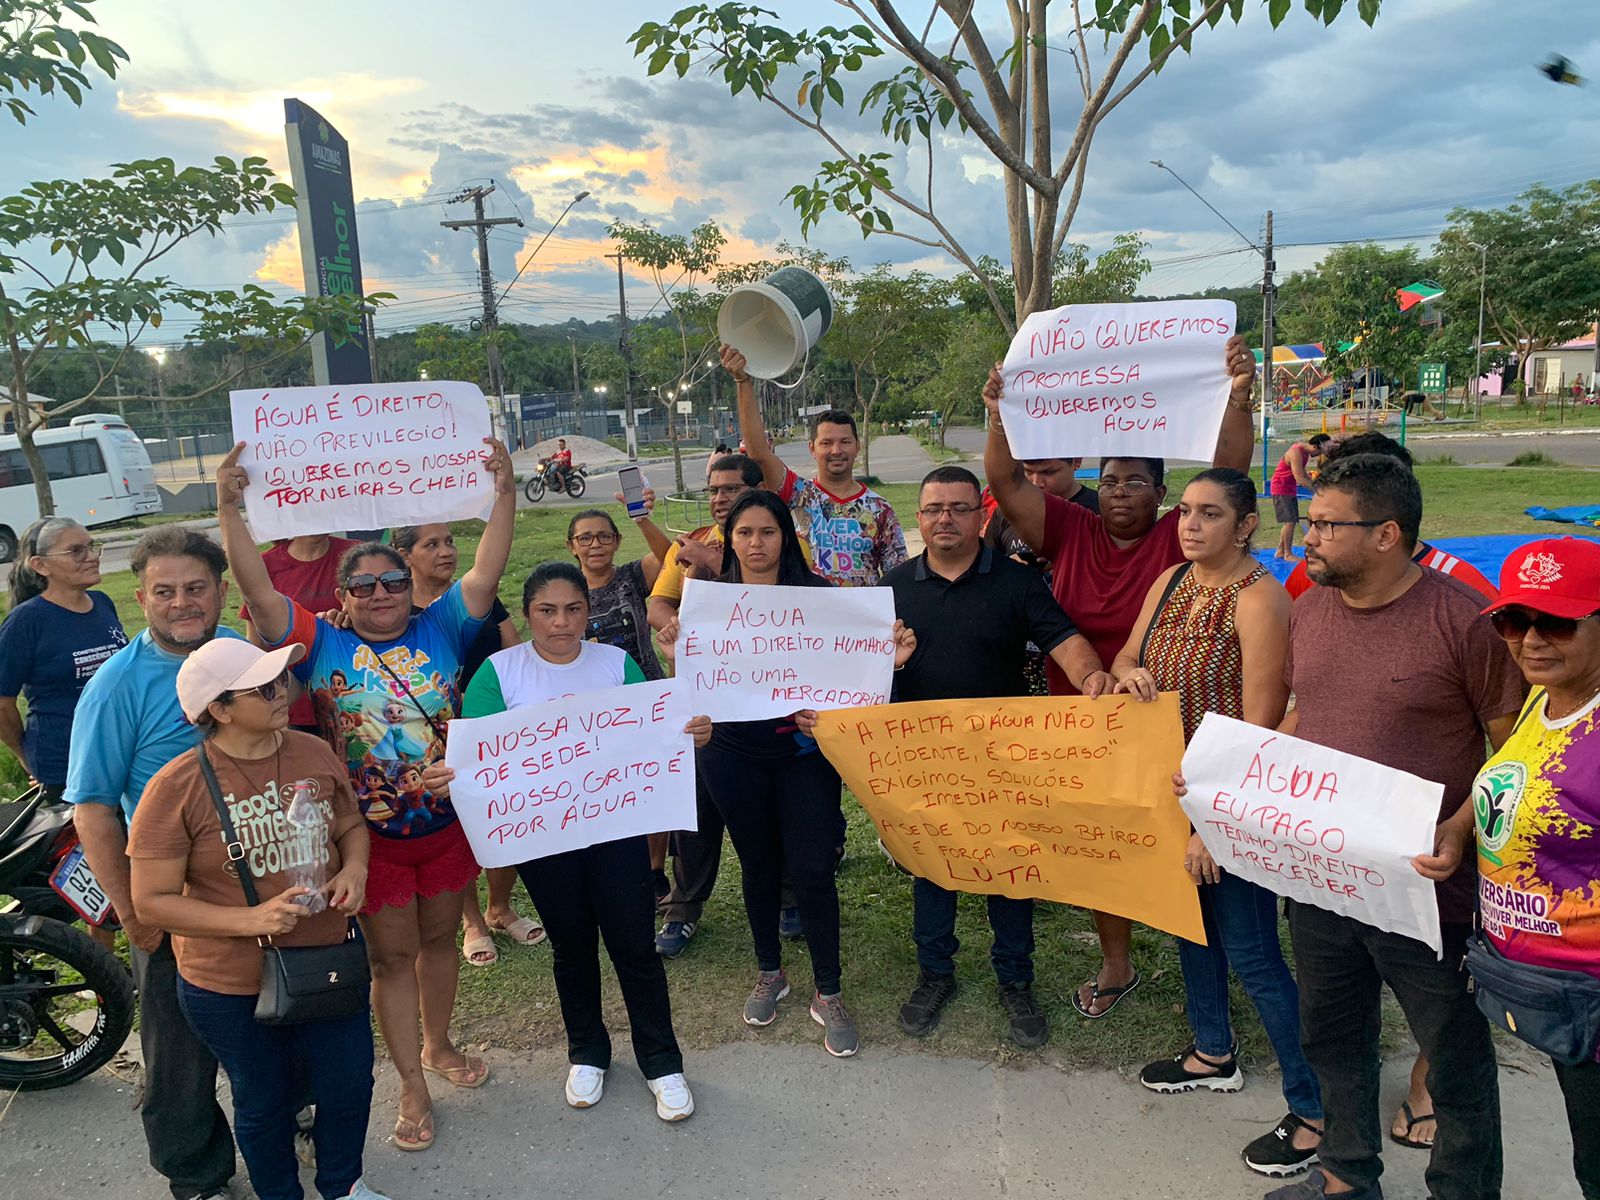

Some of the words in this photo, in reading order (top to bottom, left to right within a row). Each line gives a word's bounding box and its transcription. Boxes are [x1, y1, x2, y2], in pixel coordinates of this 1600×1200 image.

[1030, 317, 1085, 358] NÃO
[1096, 317, 1230, 349] QUEREMOS
[1012, 363, 1140, 392] PROMESSA
[255, 393, 318, 433] ÁGUA
[327, 392, 343, 420] É
[1026, 392, 1157, 418] QUEREMOS
[255, 433, 307, 461] NÃO
[265, 459, 410, 486] QUEREMOS
[422, 449, 489, 471] NOSSAS
[409, 469, 477, 494] CHEIA
[818, 549, 864, 571] KIDS
[726, 591, 805, 631] ÁGUA
[685, 631, 702, 656] É
[712, 639, 741, 656] UM
[752, 632, 824, 655] DIREITO
[696, 661, 741, 691] NÃO
[751, 667, 798, 684] UMA
[772, 685, 885, 706] MERCADORIA
[478, 716, 568, 761] NOSSA
[651, 691, 672, 722] É
[885, 715, 953, 739] FALTA
[1106, 702, 1126, 731] É
[475, 762, 510, 788] DE
[521, 736, 600, 775] SEDE!
[986, 741, 999, 761] É
[583, 761, 660, 793] GRITO
[668, 750, 686, 773] É
[868, 769, 976, 795] EXIGIMOS
[488, 815, 547, 844] POR
[881, 819, 895, 832] A
[899, 823, 952, 836] SEDE
[962, 821, 991, 835] DO
[1002, 819, 1063, 834] NOSSO
[1074, 824, 1157, 848] BAIRRO
[1212, 791, 1248, 821] EU
[1251, 805, 1345, 853] PAGO
[913, 841, 924, 855] É
[938, 845, 995, 865] FORÇA
[1008, 842, 1041, 857] DA
[1052, 843, 1122, 862] NOSSA
[1205, 820, 1277, 854] TENHO
[1284, 844, 1384, 887] DIREITO
[1514, 914, 1559, 934] MELHOR
